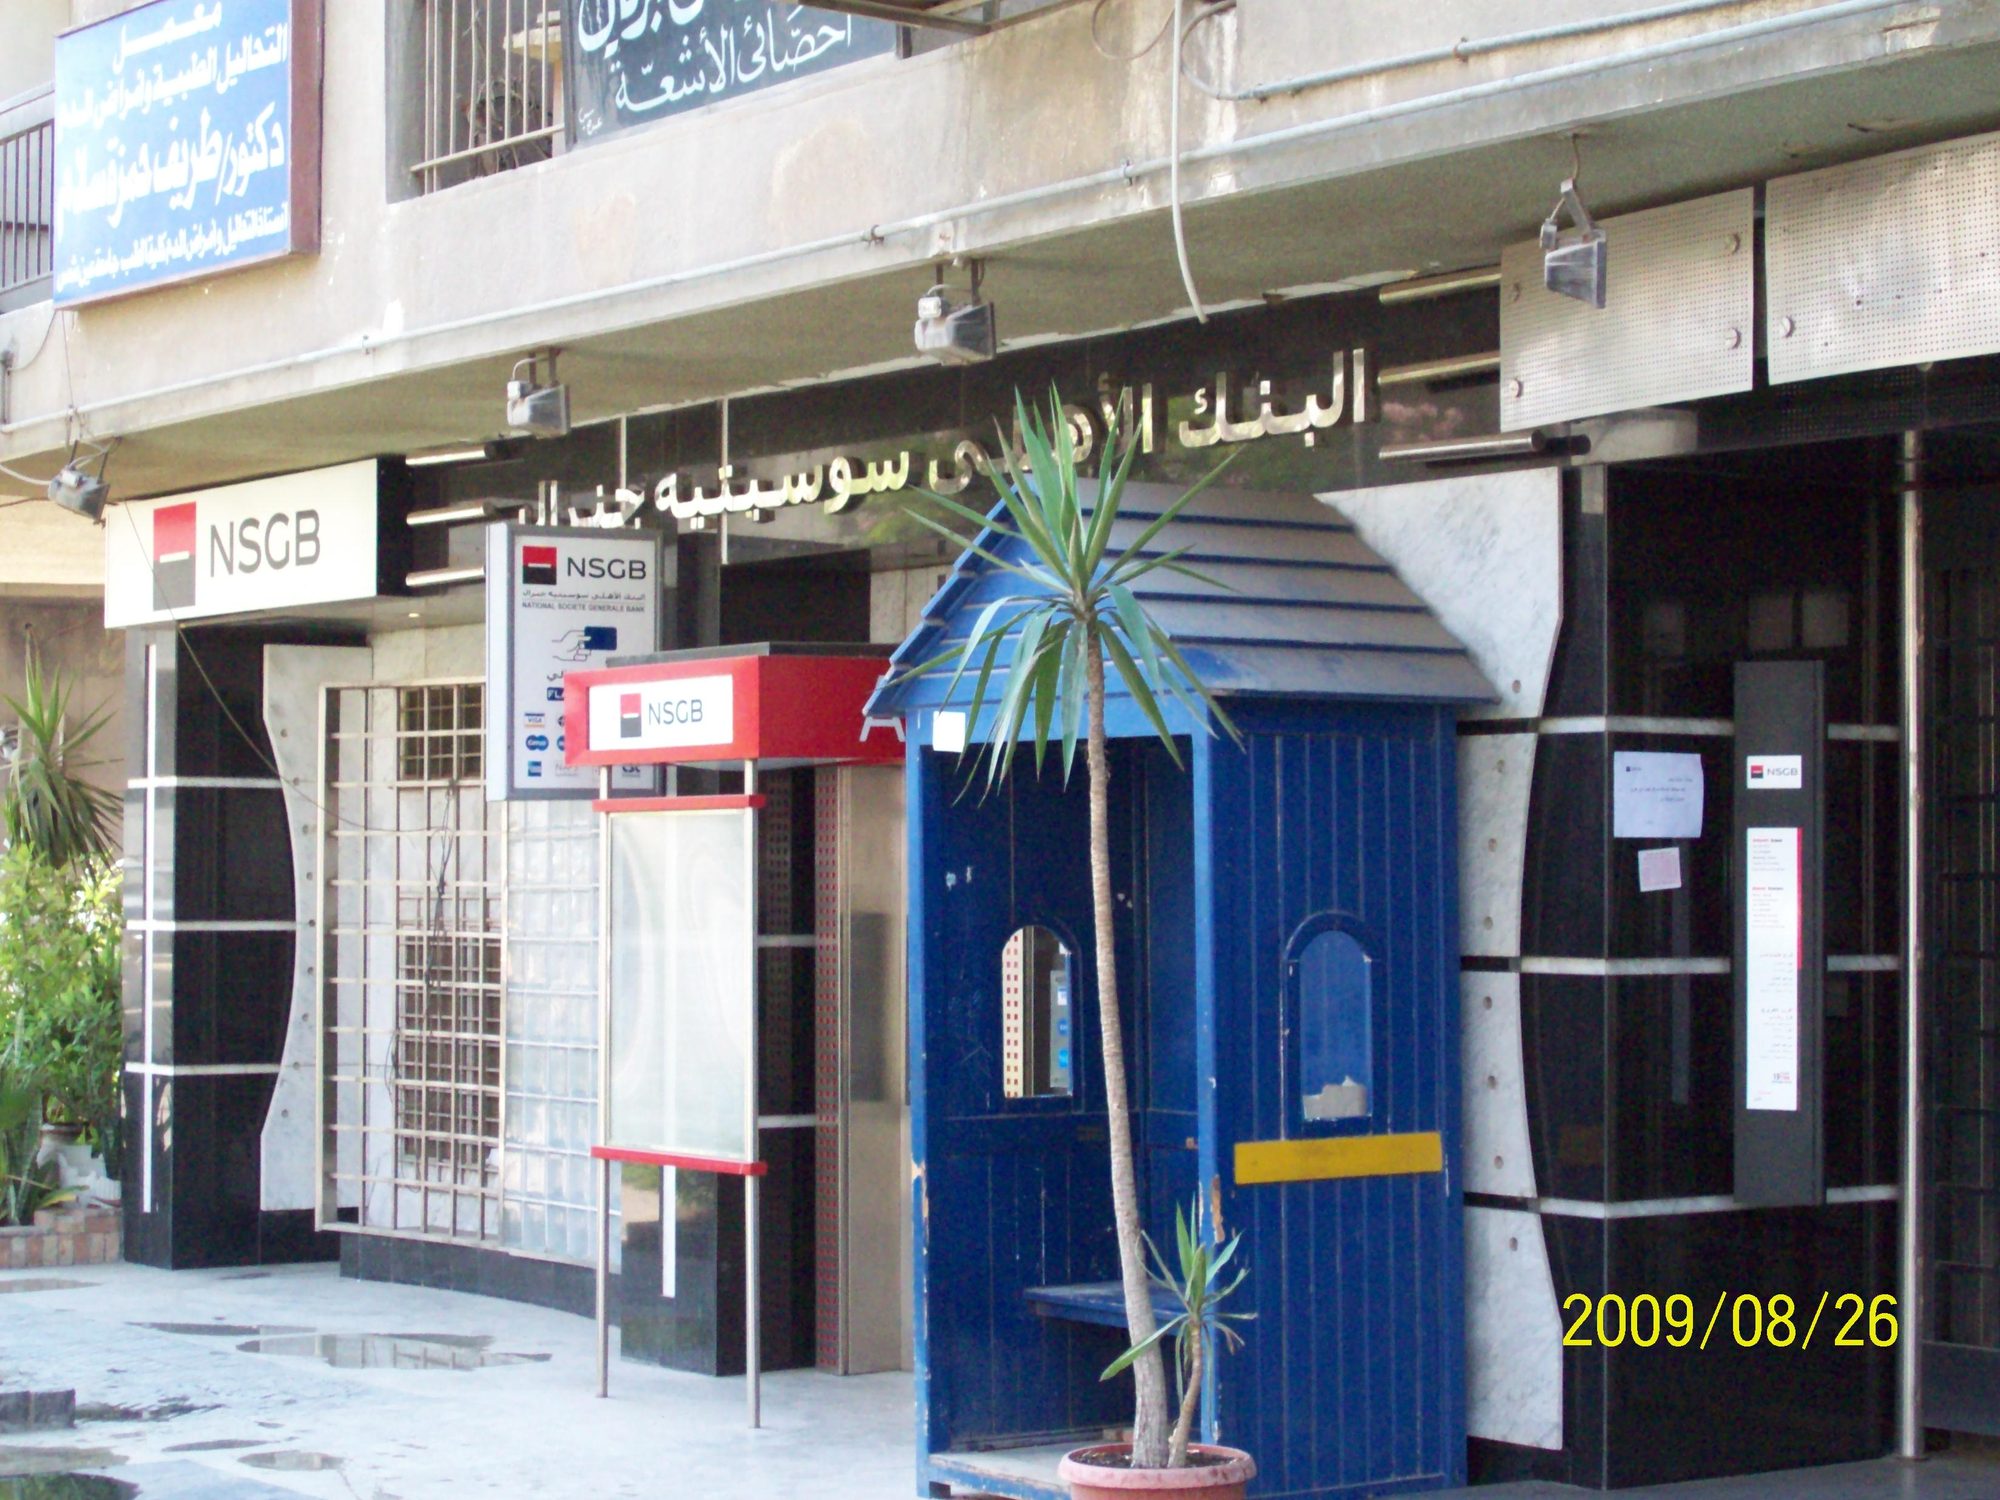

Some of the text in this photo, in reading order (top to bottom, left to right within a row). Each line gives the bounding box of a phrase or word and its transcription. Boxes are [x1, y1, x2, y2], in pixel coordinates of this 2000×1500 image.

[112, 1, 222, 74] معمل
[216, 23, 288, 94] التحاليل
[152, 45, 217, 107] الطبية
[153, 105, 223, 211] طريف
[1179, 347, 1365, 448] البنك
[655, 451, 909, 530] سوسيتيه
[210, 508, 320, 577] NSGB
[567, 557, 646, 580] NSGB
[522, 602, 555, 610] NATIONAL
[588, 604, 624, 612] GENERALE
[626, 605, 645, 613] BANK
[649, 699, 703, 725] NSGB
[1767, 767, 1799, 777] NSGB
